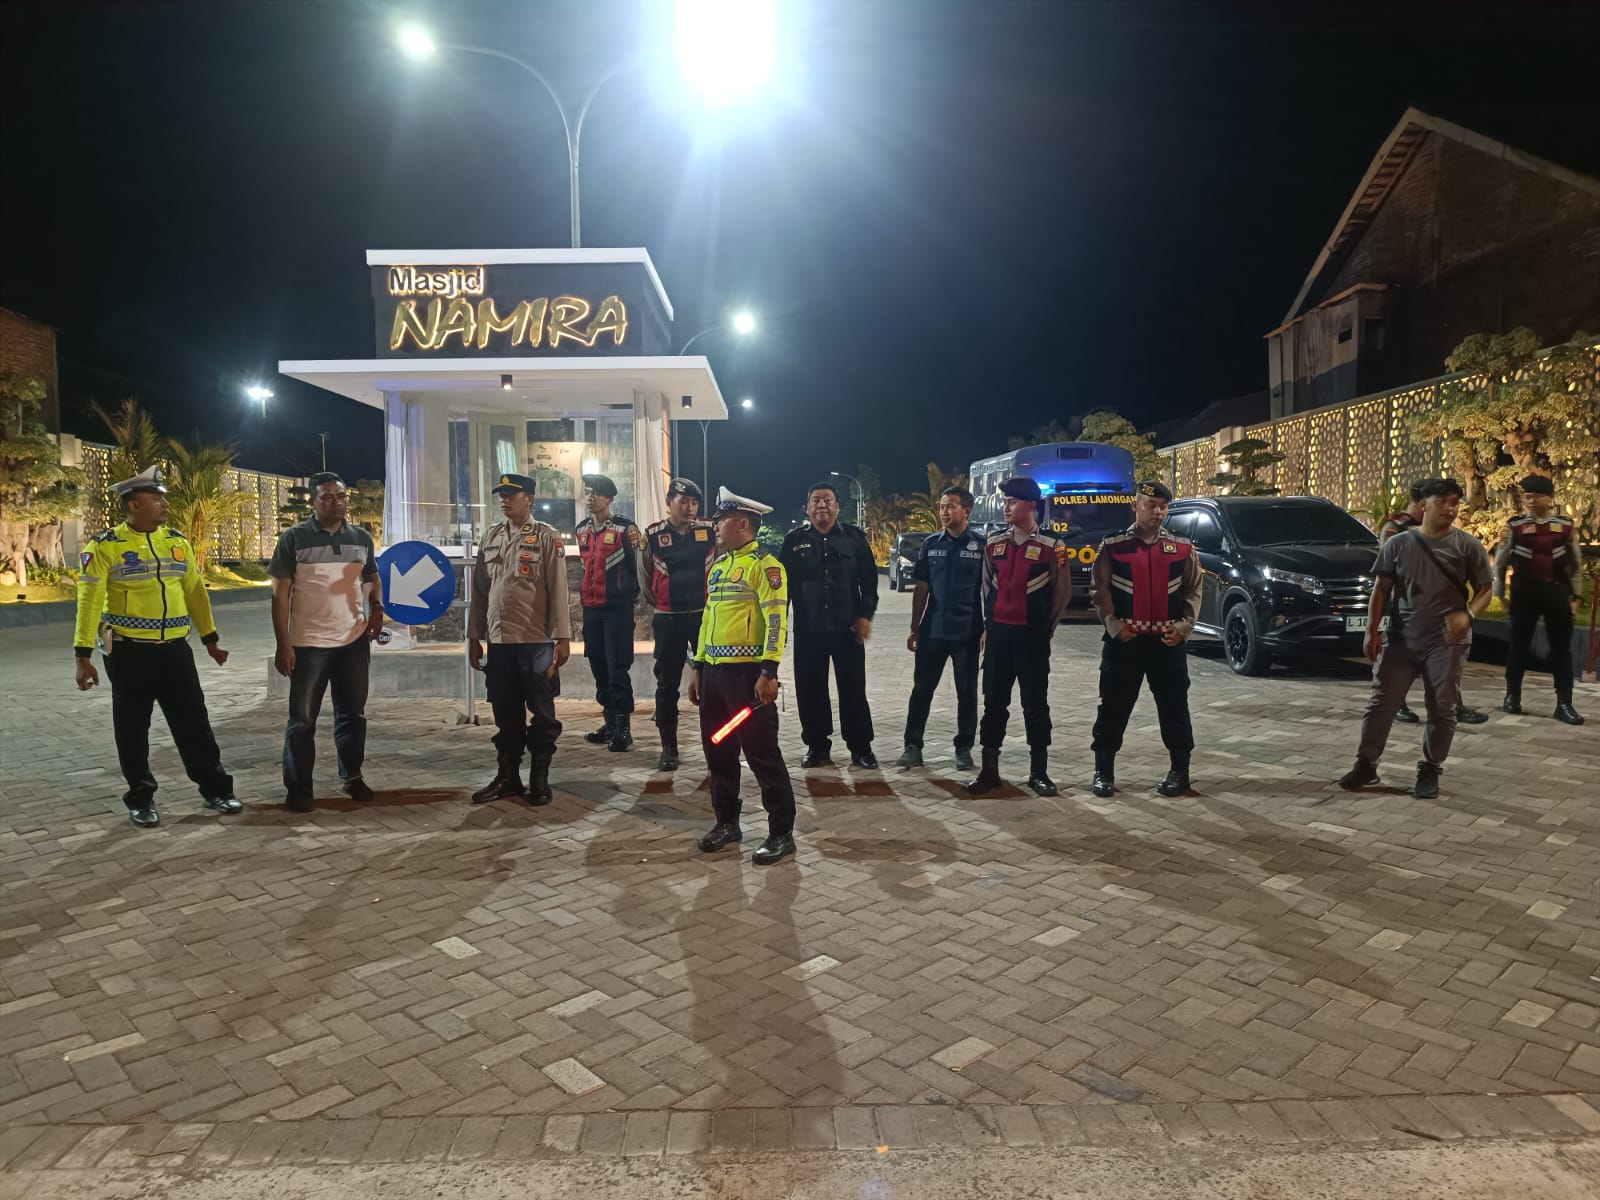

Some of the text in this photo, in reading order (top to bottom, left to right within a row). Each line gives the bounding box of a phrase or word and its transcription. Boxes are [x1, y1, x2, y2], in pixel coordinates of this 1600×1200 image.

[388, 266, 484, 297] Masjid
[390, 296, 628, 349] NAMIRA
[1053, 495, 1088, 506] POLRES
[1052, 522, 1069, 533] 02
